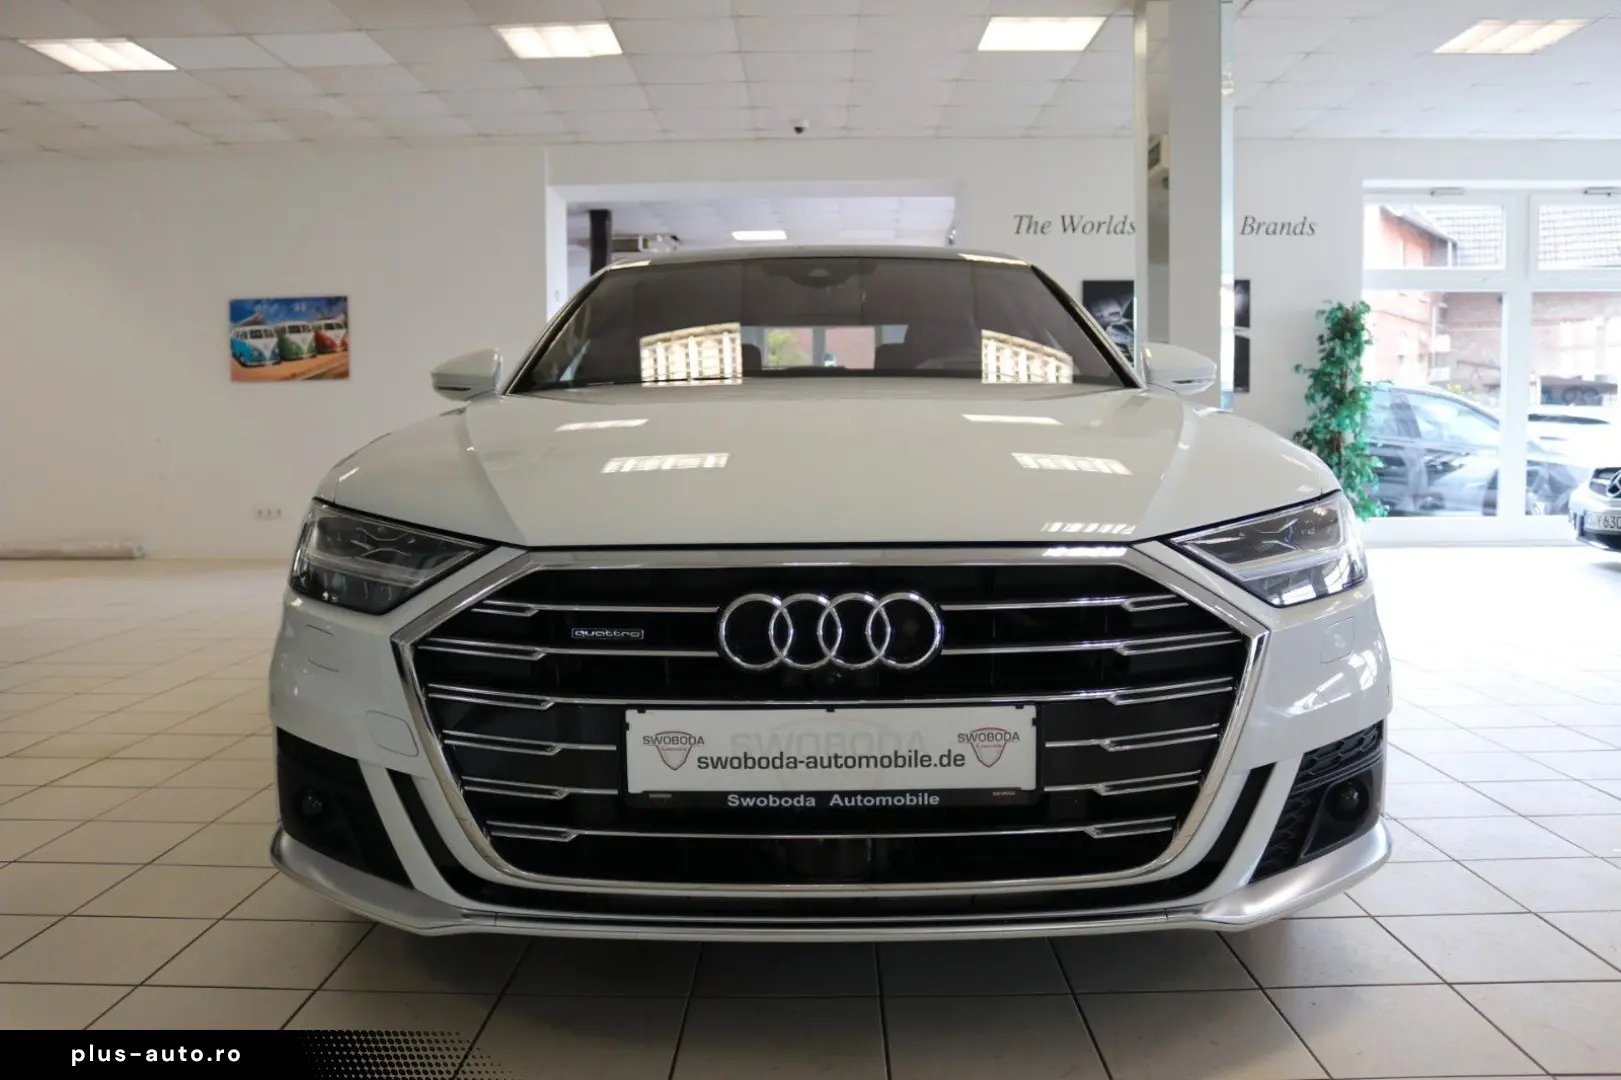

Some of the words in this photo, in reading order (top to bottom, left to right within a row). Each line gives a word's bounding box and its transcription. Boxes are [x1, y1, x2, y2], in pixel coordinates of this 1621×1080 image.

[1013, 214, 1052, 235] The
[1060, 214, 1136, 236] Worlds
[1240, 215, 1317, 236] Brands
[574, 630, 641, 638] quattro
[642, 735, 705, 746] SWOBODA
[957, 731, 1020, 743] SWOBODA
[697, 749, 966, 770] swoboda-automobile.de
[727, 794, 816, 808] Swoboda
[829, 792, 940, 807] Automobile
